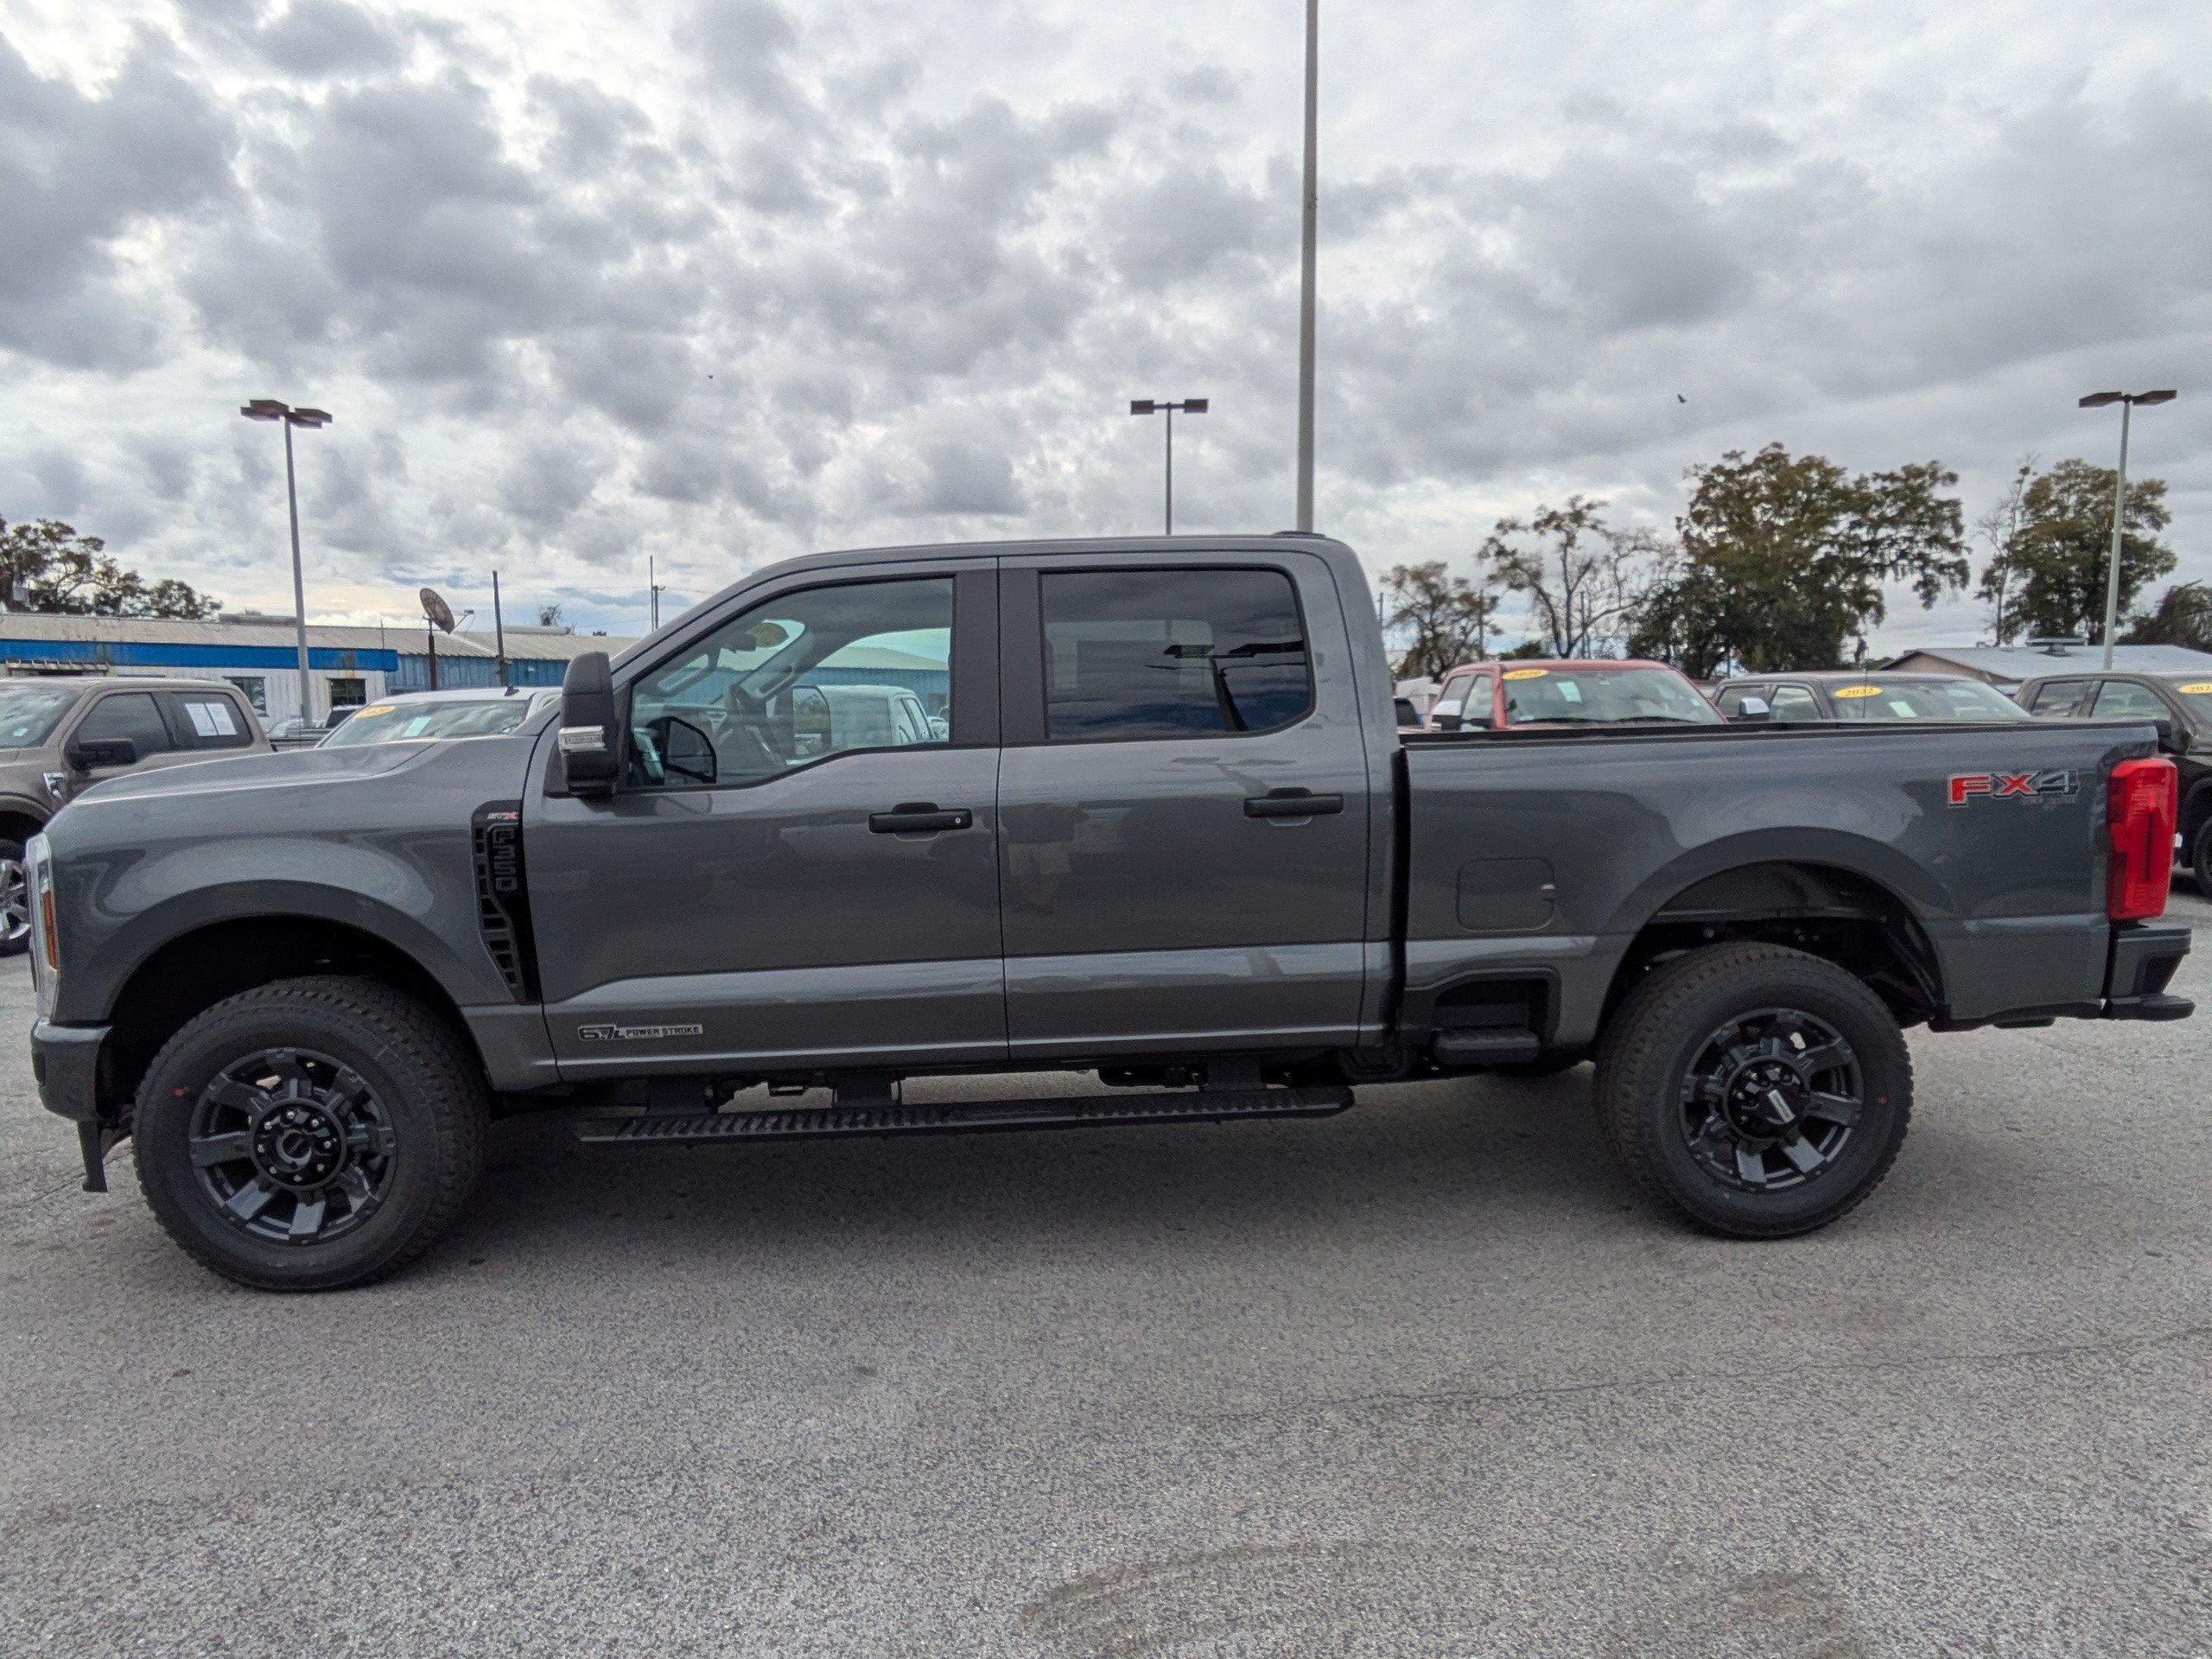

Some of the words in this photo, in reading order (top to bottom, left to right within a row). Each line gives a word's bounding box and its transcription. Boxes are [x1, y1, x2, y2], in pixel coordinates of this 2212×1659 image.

[1948, 769, 2078, 807] FX4
[626, 1027, 659, 1037] POWER
[662, 1026, 700, 1036] STROKE
